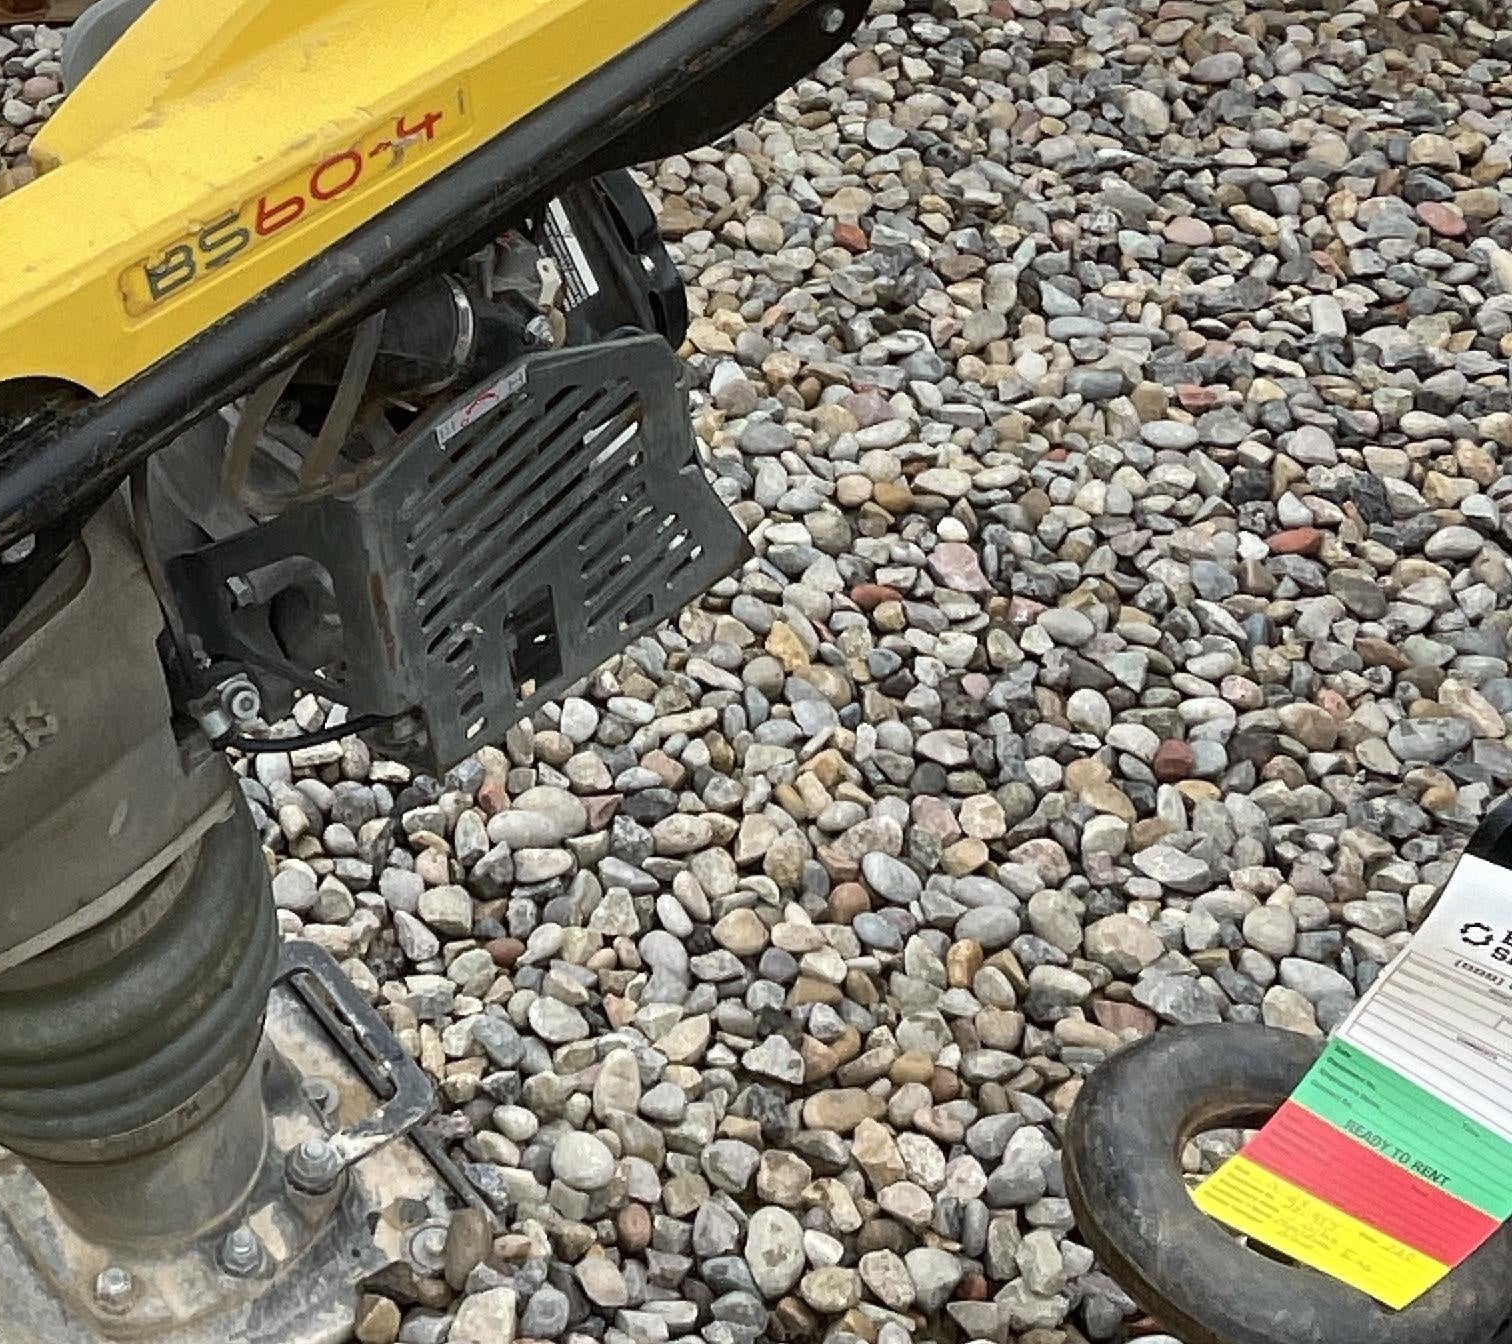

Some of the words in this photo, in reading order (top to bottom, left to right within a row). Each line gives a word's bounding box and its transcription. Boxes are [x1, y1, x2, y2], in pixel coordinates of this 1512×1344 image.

[1344, 1118, 1392, 1156] READY
[1391, 1146, 1412, 1164] TO
[1410, 1158, 1451, 1186] RENT
